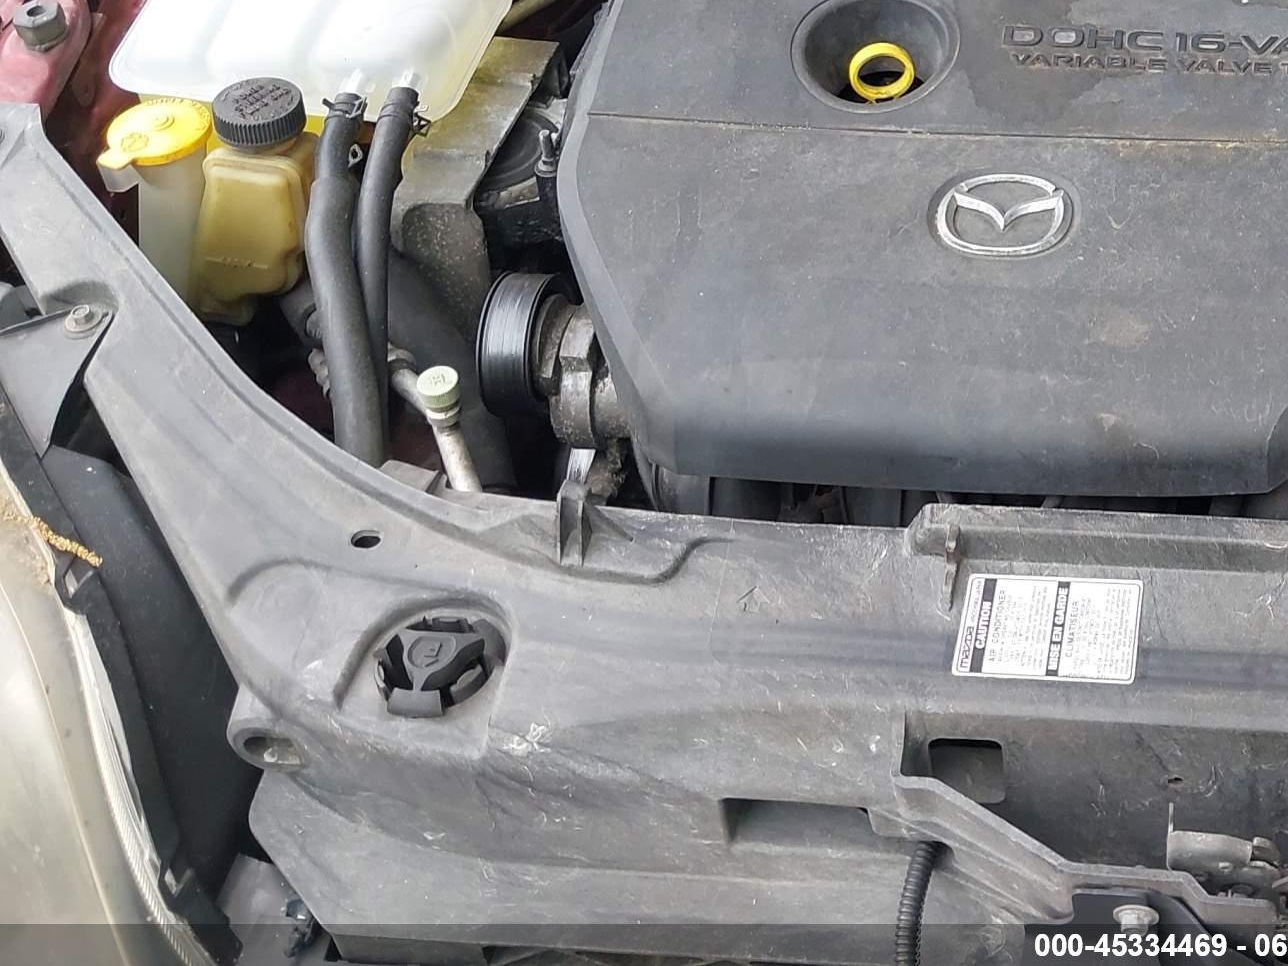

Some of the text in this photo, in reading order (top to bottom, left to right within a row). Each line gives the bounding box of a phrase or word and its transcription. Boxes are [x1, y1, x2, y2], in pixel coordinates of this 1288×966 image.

[1002, 25, 1164, 52] DOHC
[1010, 53, 1167, 71] VARIABLE
[1176, 57, 1273, 75] VALVE
[975, 601, 992, 649] CAUTION
[991, 589, 1005, 644] CONDITIONER
[1047, 586, 1069, 671] MISE EN GARDE
